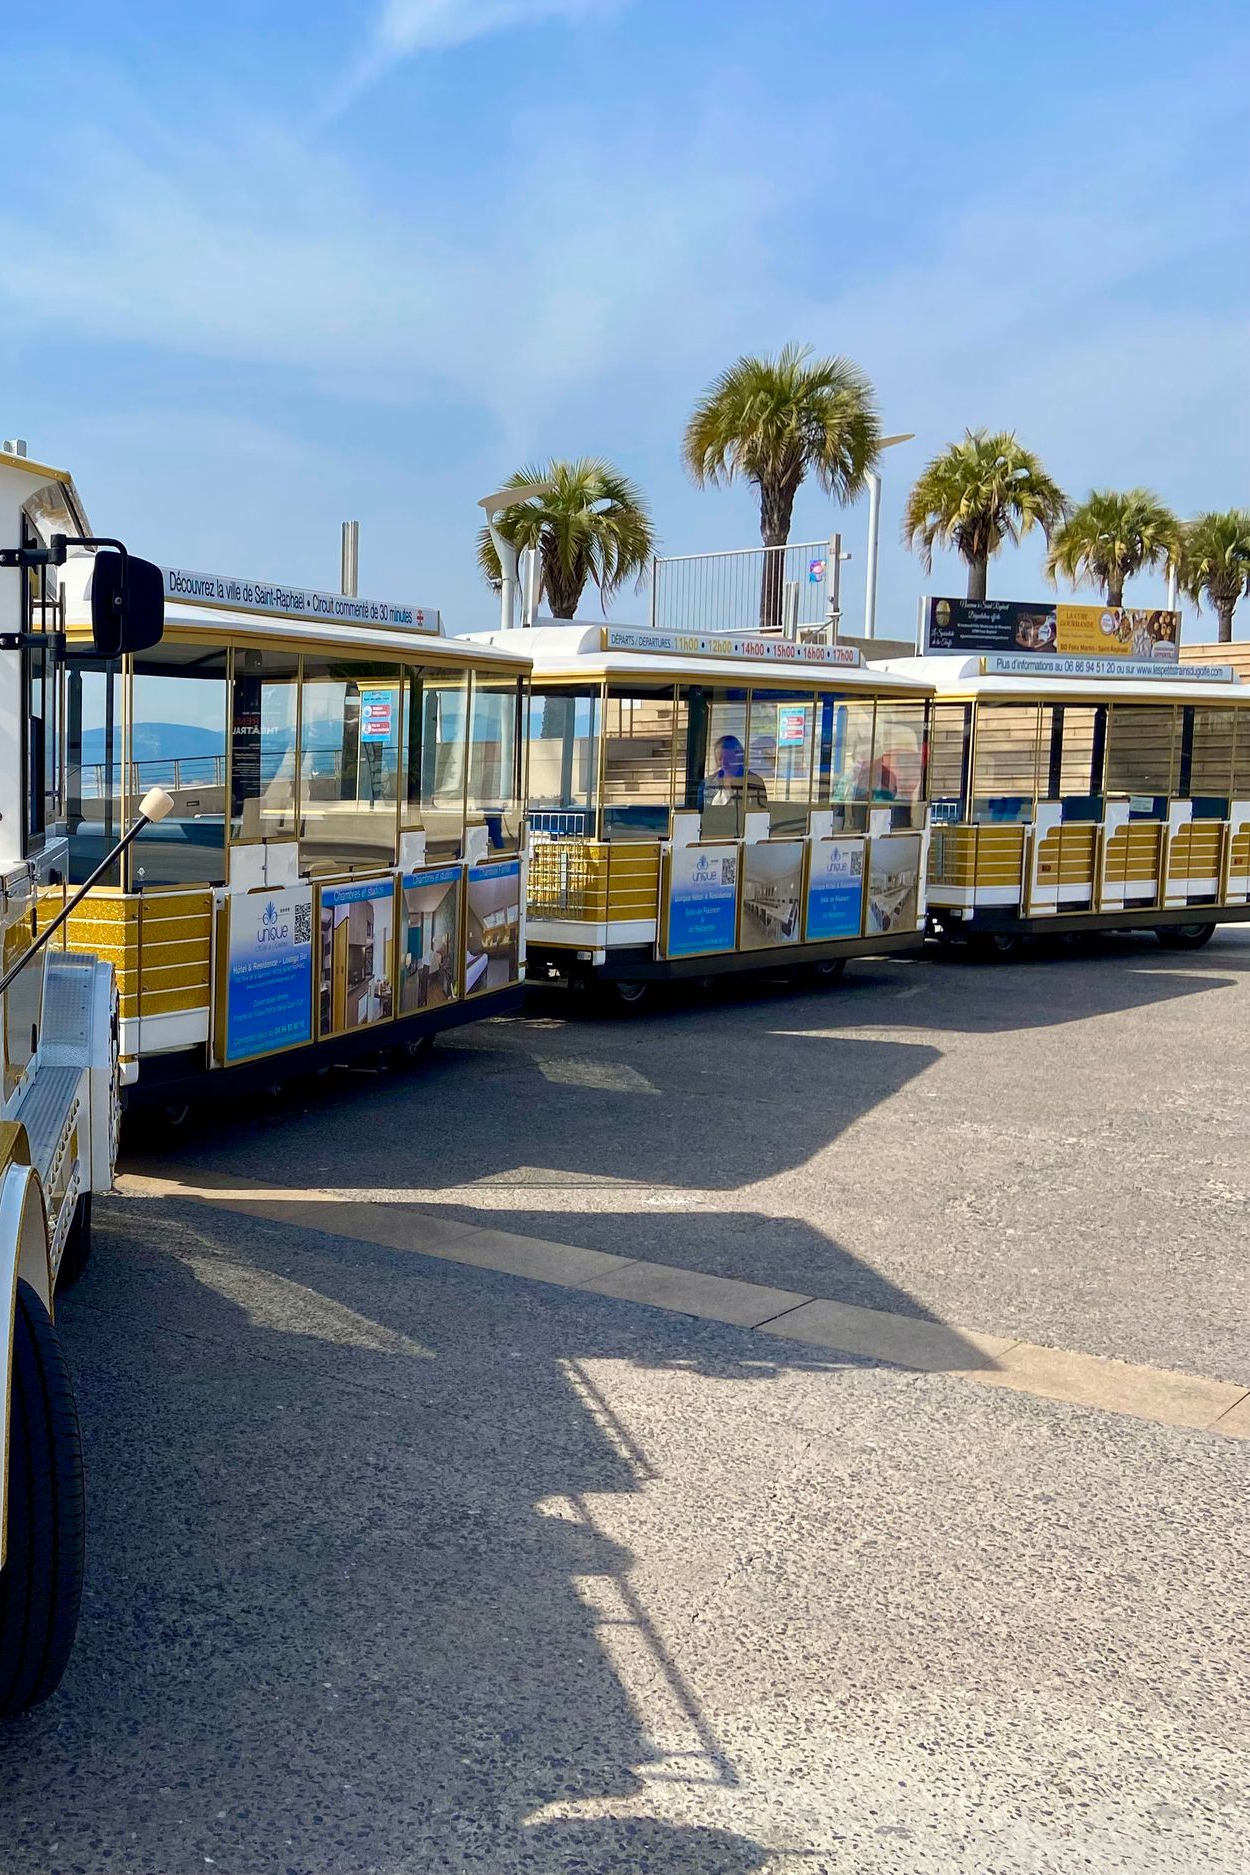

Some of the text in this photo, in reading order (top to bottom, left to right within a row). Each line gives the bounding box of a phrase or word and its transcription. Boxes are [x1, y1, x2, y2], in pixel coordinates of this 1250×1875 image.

[170, 570, 214, 597] Découvrez
[216, 579, 224, 599] la
[226, 581, 241, 601] ville
[243, 584, 253, 603] de
[254, 585, 305, 611] Saint-Raphaël
[313, 594, 334, 614] Circuit
[336, 600, 369, 619] commenté
[370, 603, 379, 620] de
[379, 604, 388, 621] 30
[390, 605, 412, 624] minutes
[674, 637, 699, 651] 11h00
[708, 639, 732, 653] 12h00
[741, 642, 765, 656] 14h00
[773, 644, 795, 658] 15h00
[803, 647, 825, 660] 16h00
[833, 649, 854, 662] 17h00
[996, 658, 1010, 669] Plus
[1011, 659, 1053, 671] d'informations
[1055, 663, 1063, 672] au
[1064, 660, 1074, 672] 06
[1075, 660, 1084, 672] 86
[1085, 661, 1095, 673] 94
[1096, 661, 1105, 673] 51
[1106, 662, 1115, 674] 20
[1117, 666, 1125, 674] ou
[1125, 666, 1135, 674] sur
[334, 889, 360, 902] Chambres
